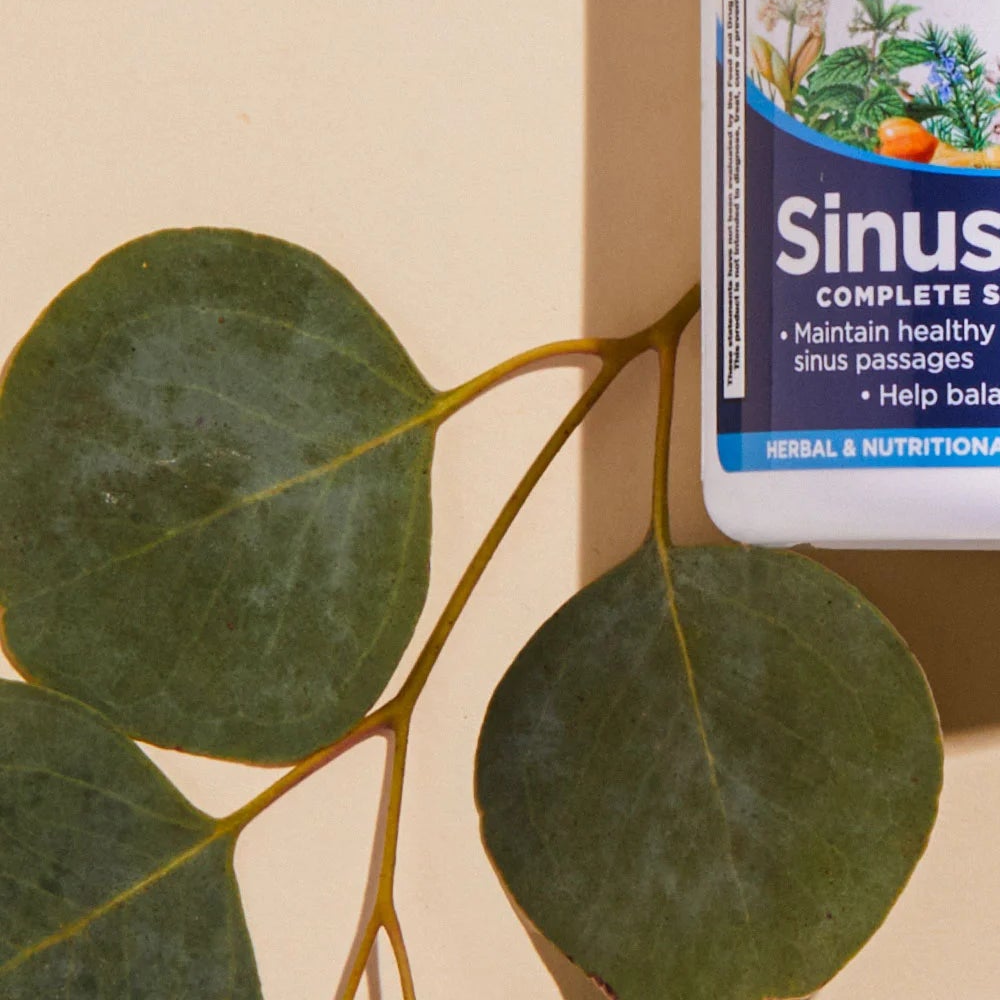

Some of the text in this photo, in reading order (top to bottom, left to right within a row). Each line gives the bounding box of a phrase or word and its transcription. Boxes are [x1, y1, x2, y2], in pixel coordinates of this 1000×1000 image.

[816, 285, 970, 307] COMPLETE
[794, 319, 996, 346] Maintain healthy
[794, 349, 974, 374] sinus passages
[879, 383, 938, 409] Help
[766, 439, 837, 459] HERBAL
[842, 438, 857, 457] &
